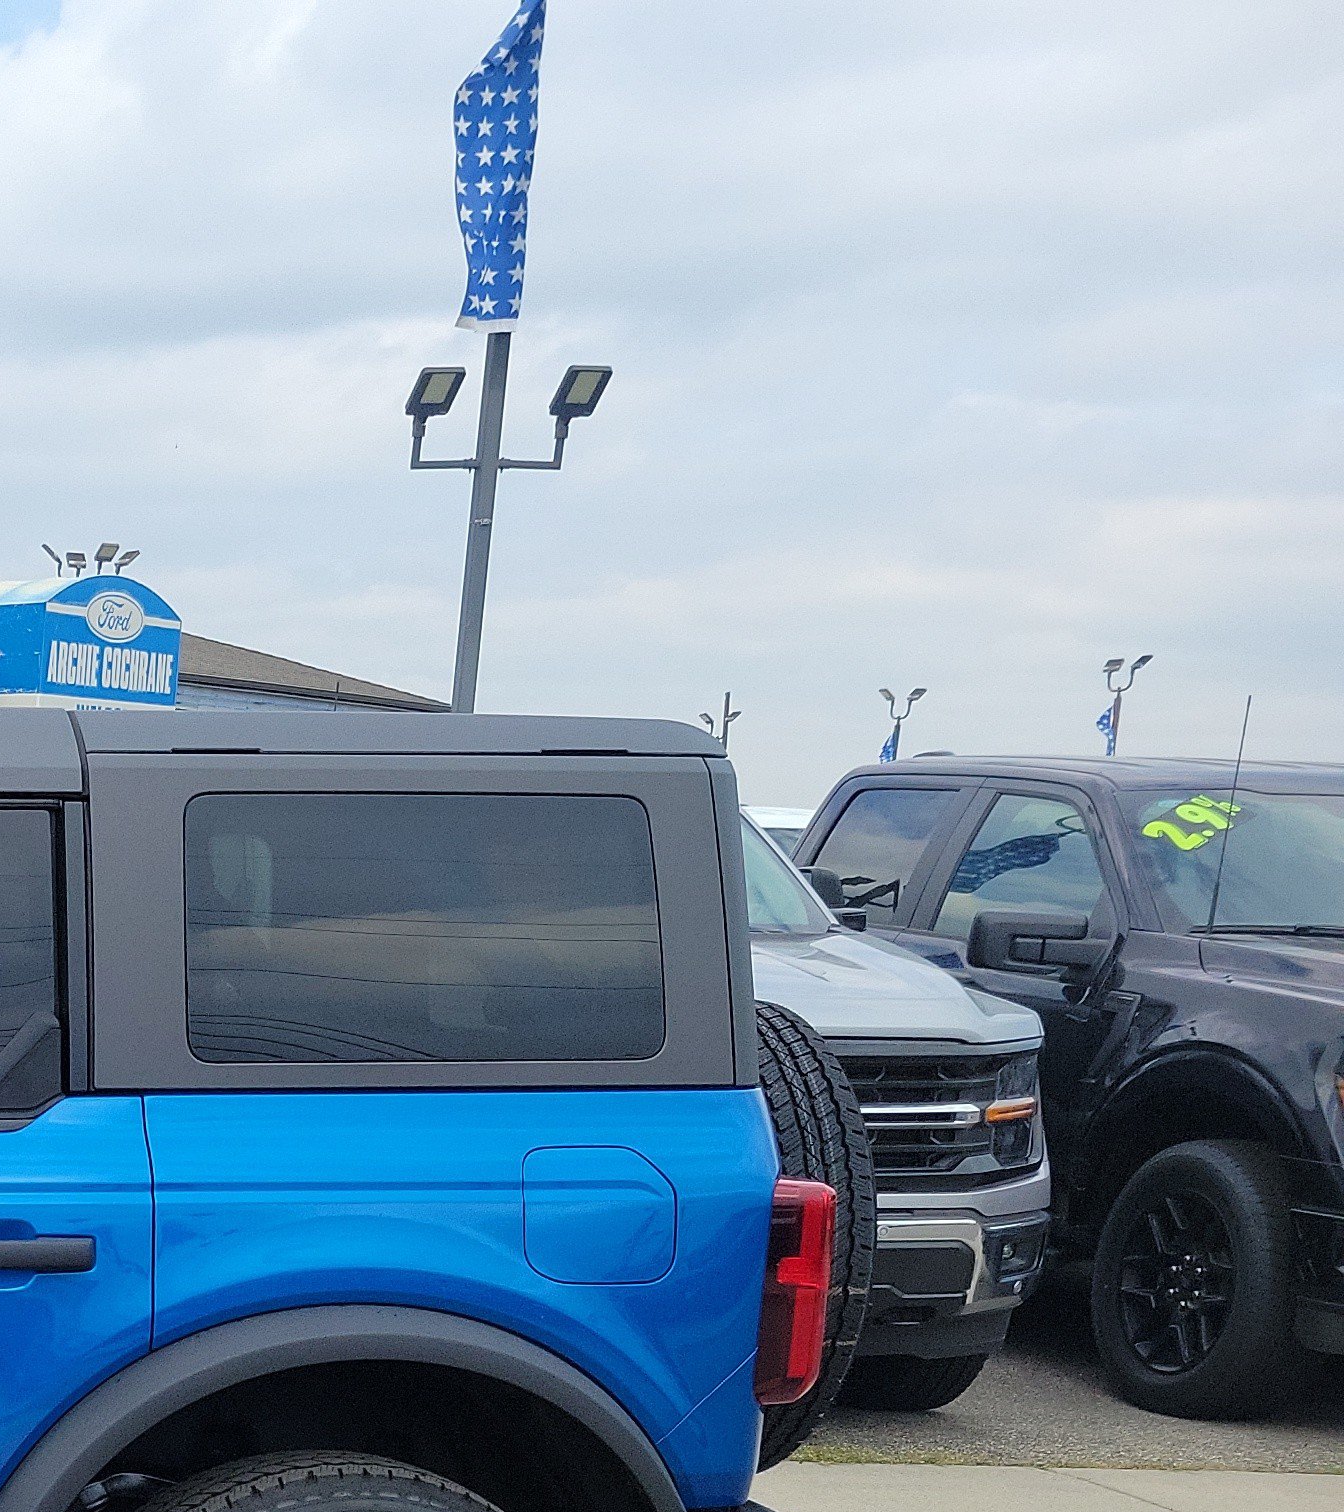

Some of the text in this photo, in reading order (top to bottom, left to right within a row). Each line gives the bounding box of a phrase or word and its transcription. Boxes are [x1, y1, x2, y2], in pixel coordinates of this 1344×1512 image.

[97, 599, 133, 632] Ford
[47, 640, 174, 695] ARCHIE COCHRANE
